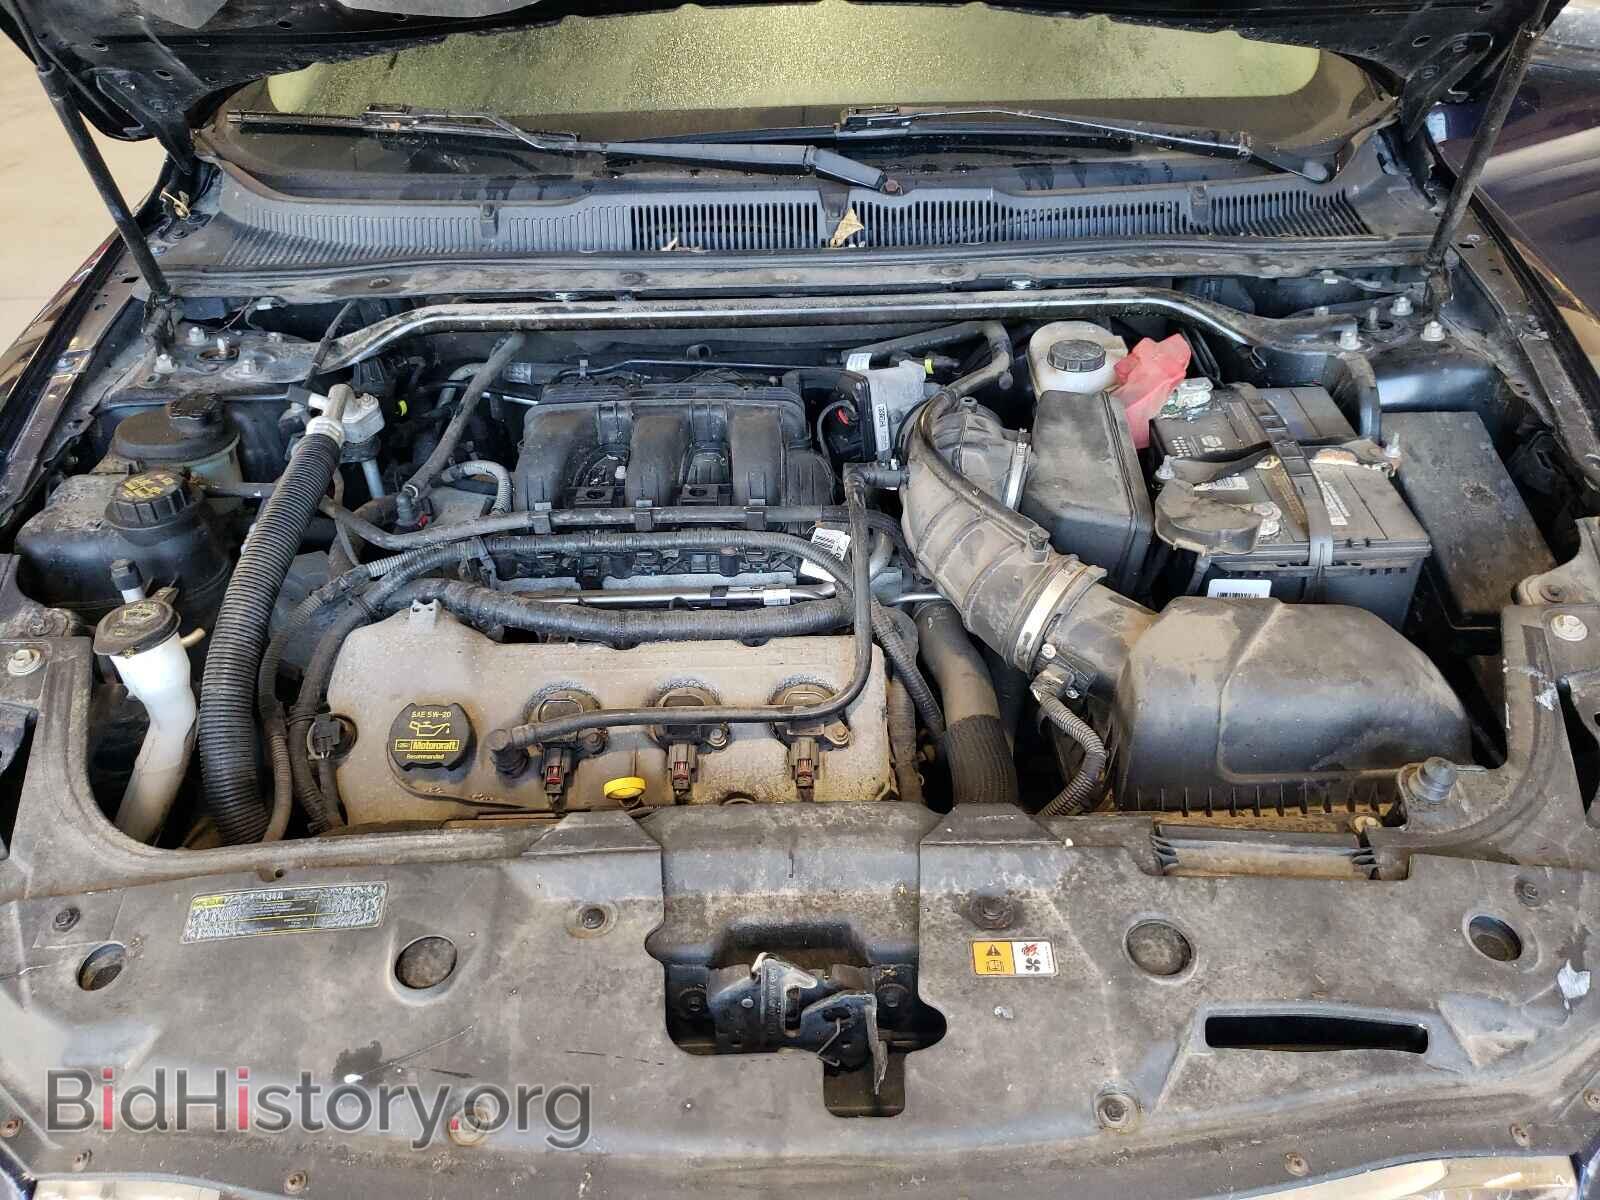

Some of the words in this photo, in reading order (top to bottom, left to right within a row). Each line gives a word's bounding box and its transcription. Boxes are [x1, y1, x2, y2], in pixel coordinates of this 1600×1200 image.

[411, 710, 426, 718] SAE
[427, 710, 452, 718] 5W-20
[412, 740, 457, 750] Motorcraft
